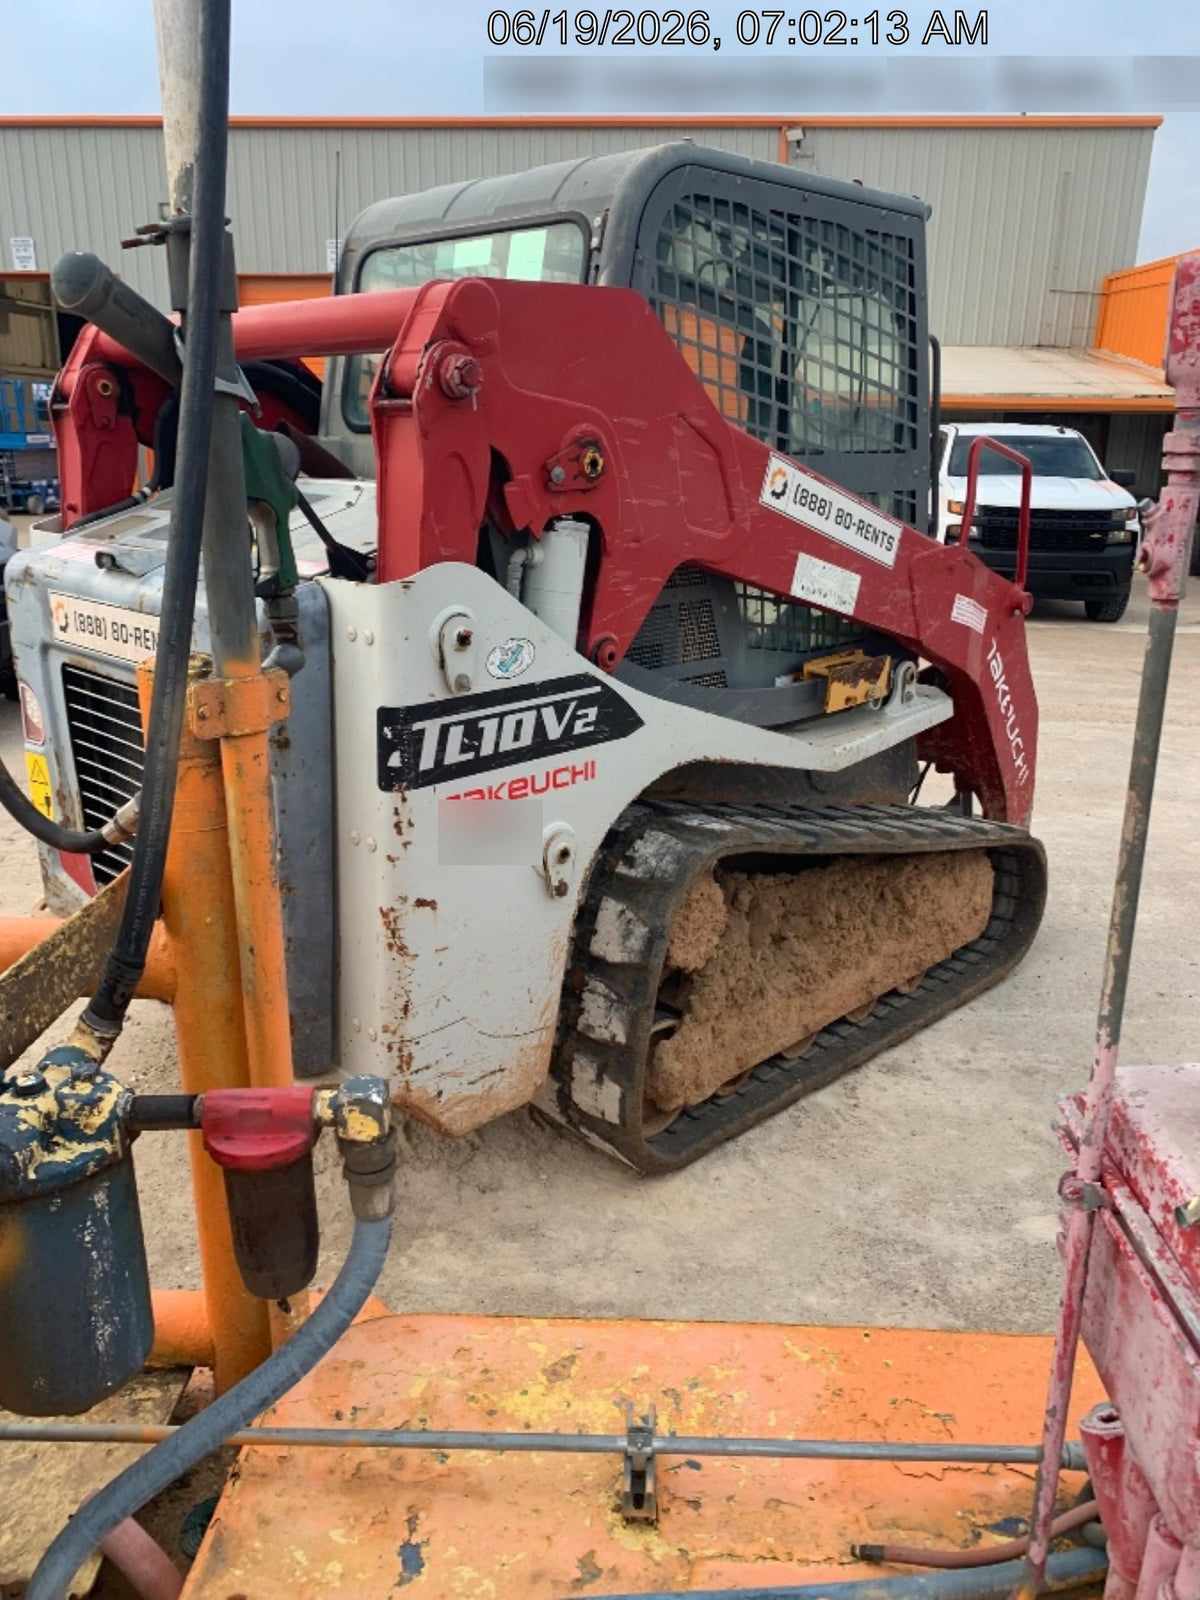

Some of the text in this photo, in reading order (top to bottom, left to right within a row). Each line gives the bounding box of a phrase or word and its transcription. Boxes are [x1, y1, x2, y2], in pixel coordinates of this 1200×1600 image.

[793, 483, 895, 552] (888) 80-RENTS
[73, 610, 160, 652] (888) 80-REN
[411, 700, 599, 772] TL10V2
